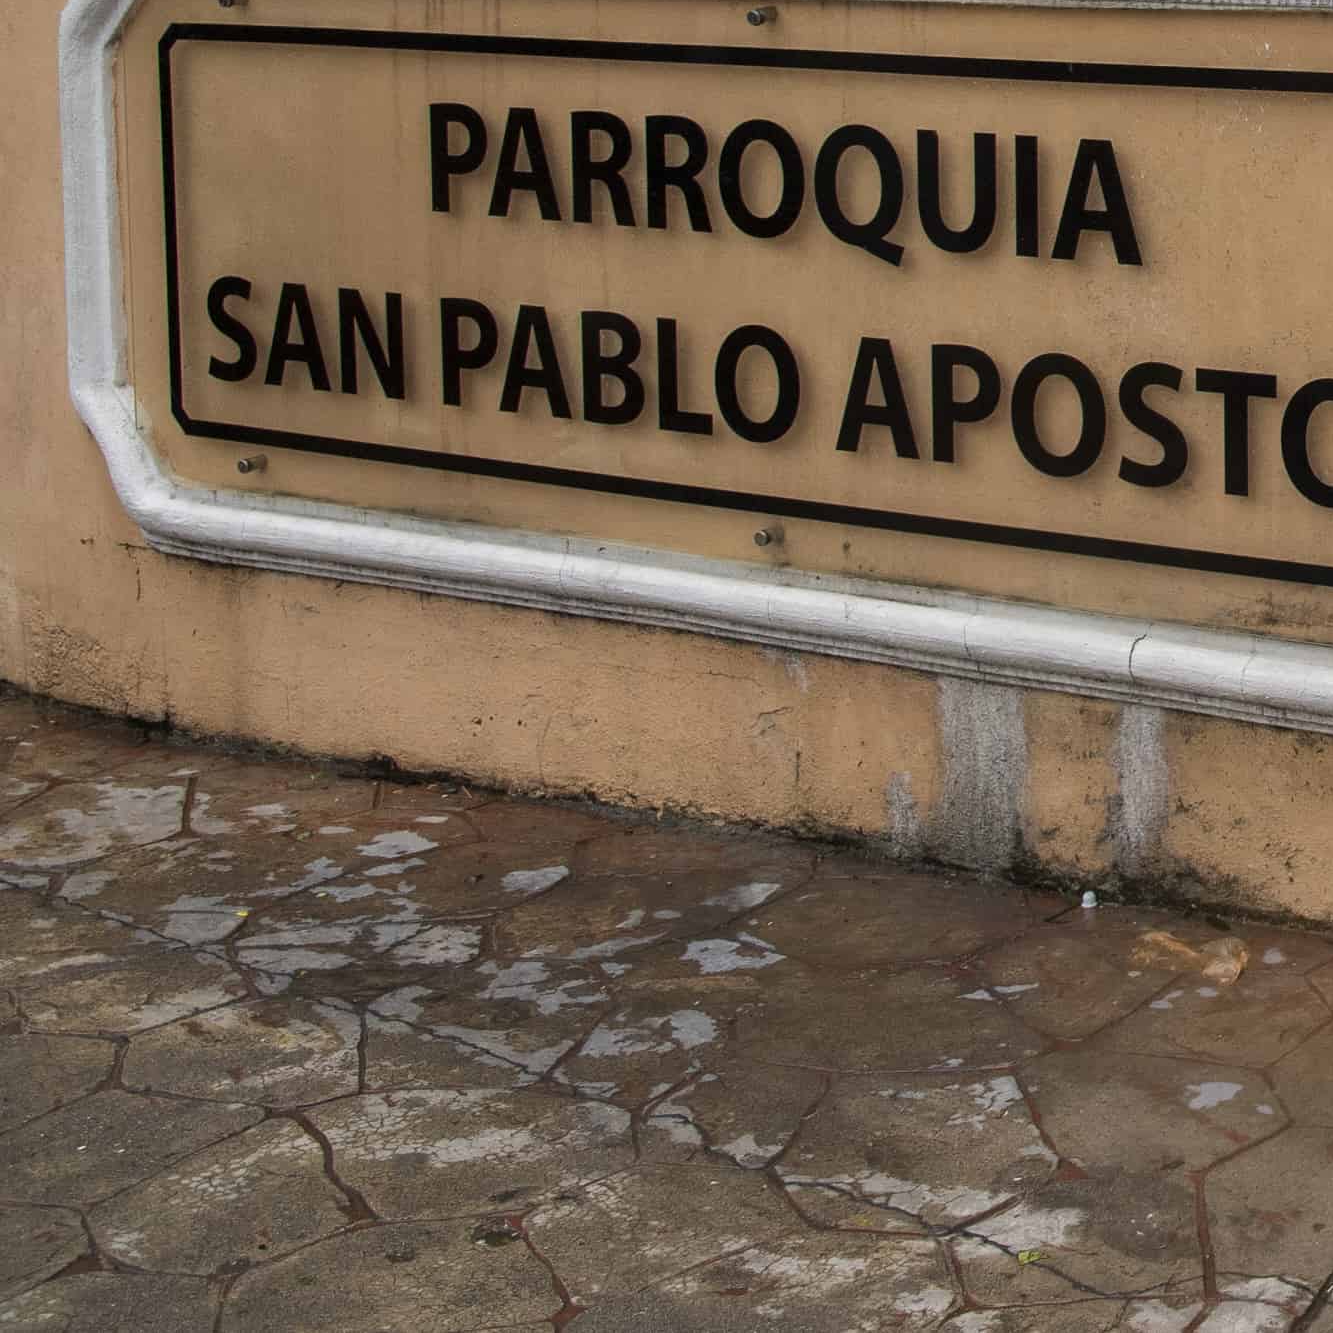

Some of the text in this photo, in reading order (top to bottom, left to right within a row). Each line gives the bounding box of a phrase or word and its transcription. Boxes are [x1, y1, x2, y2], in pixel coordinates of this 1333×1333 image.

[429, 103, 1143, 266] PARROQUIA
[206, 276, 405, 400] SAN
[441, 297, 801, 443] PABLO
